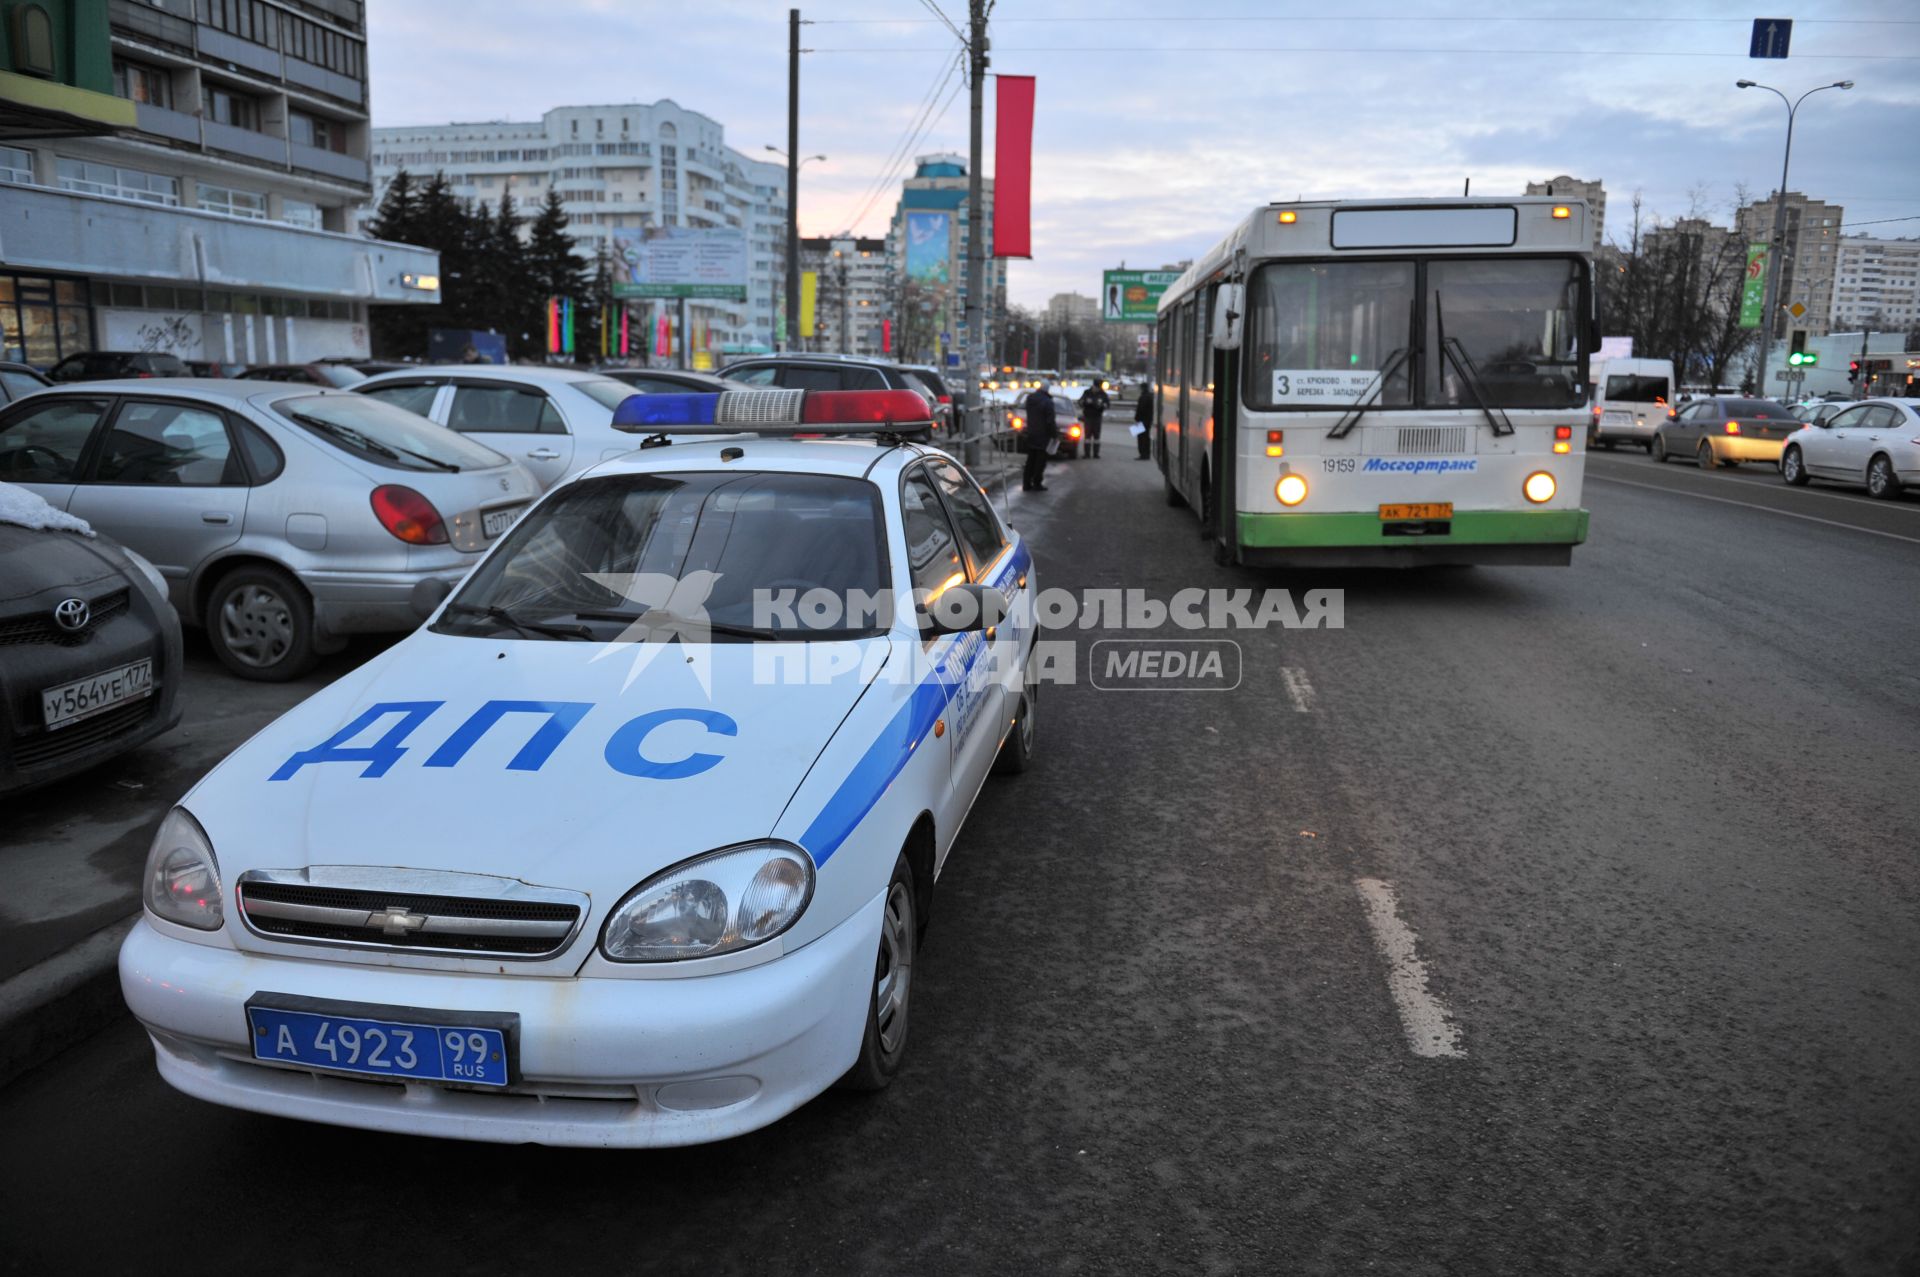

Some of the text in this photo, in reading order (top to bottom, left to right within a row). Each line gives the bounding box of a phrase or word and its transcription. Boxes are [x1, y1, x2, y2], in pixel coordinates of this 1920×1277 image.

[1278, 375, 1290, 396] 3
[1307, 377, 1340, 385] КРЮКОВО
[1297, 388, 1324, 396] БЕРЕЗКА
[1322, 458, 1355, 473] 19159
[1362, 458, 1477, 474] Мосгортранс
[51, 663, 148, 718] У564УЕ 177
[268, 700, 738, 782] ДПС
[276, 1022, 488, 1069] А 4923 99
[453, 1063, 485, 1078] RUS
